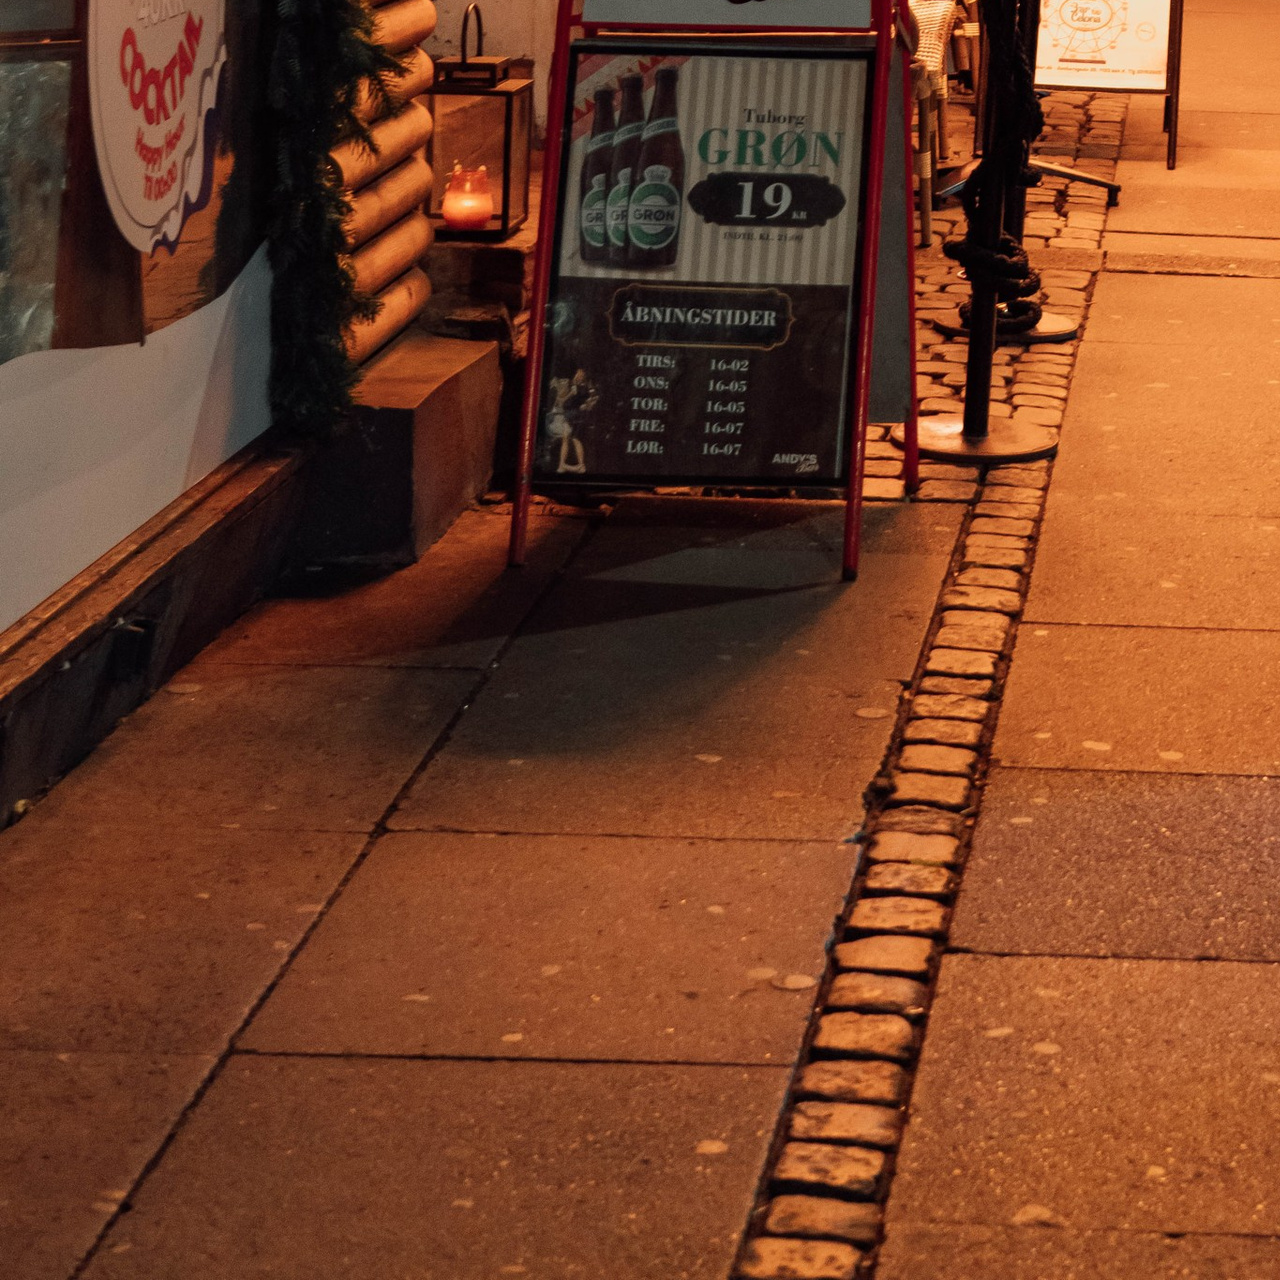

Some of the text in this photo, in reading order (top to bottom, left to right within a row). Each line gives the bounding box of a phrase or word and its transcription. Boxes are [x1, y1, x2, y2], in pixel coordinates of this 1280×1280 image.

[118, 10, 205, 127] COCKTAIL
[743, 107, 807, 126] Tuborg
[697, 127, 845, 169] GRØN
[734, 180, 793, 220] 19
[633, 208, 675, 221] GRØN
[620, 301, 778, 328] ÅBNINGSTIDER
[636, 354, 749, 372] TIRS: 16-02
[633, 376, 747, 392] ONS: 16-05
[631, 397, 745, 414] TOR: 16-05
[630, 419, 744, 435] FRE: 16-07
[625, 439, 742, 457] LØR: 16-07
[772, 452, 817, 466] ANDY'S
